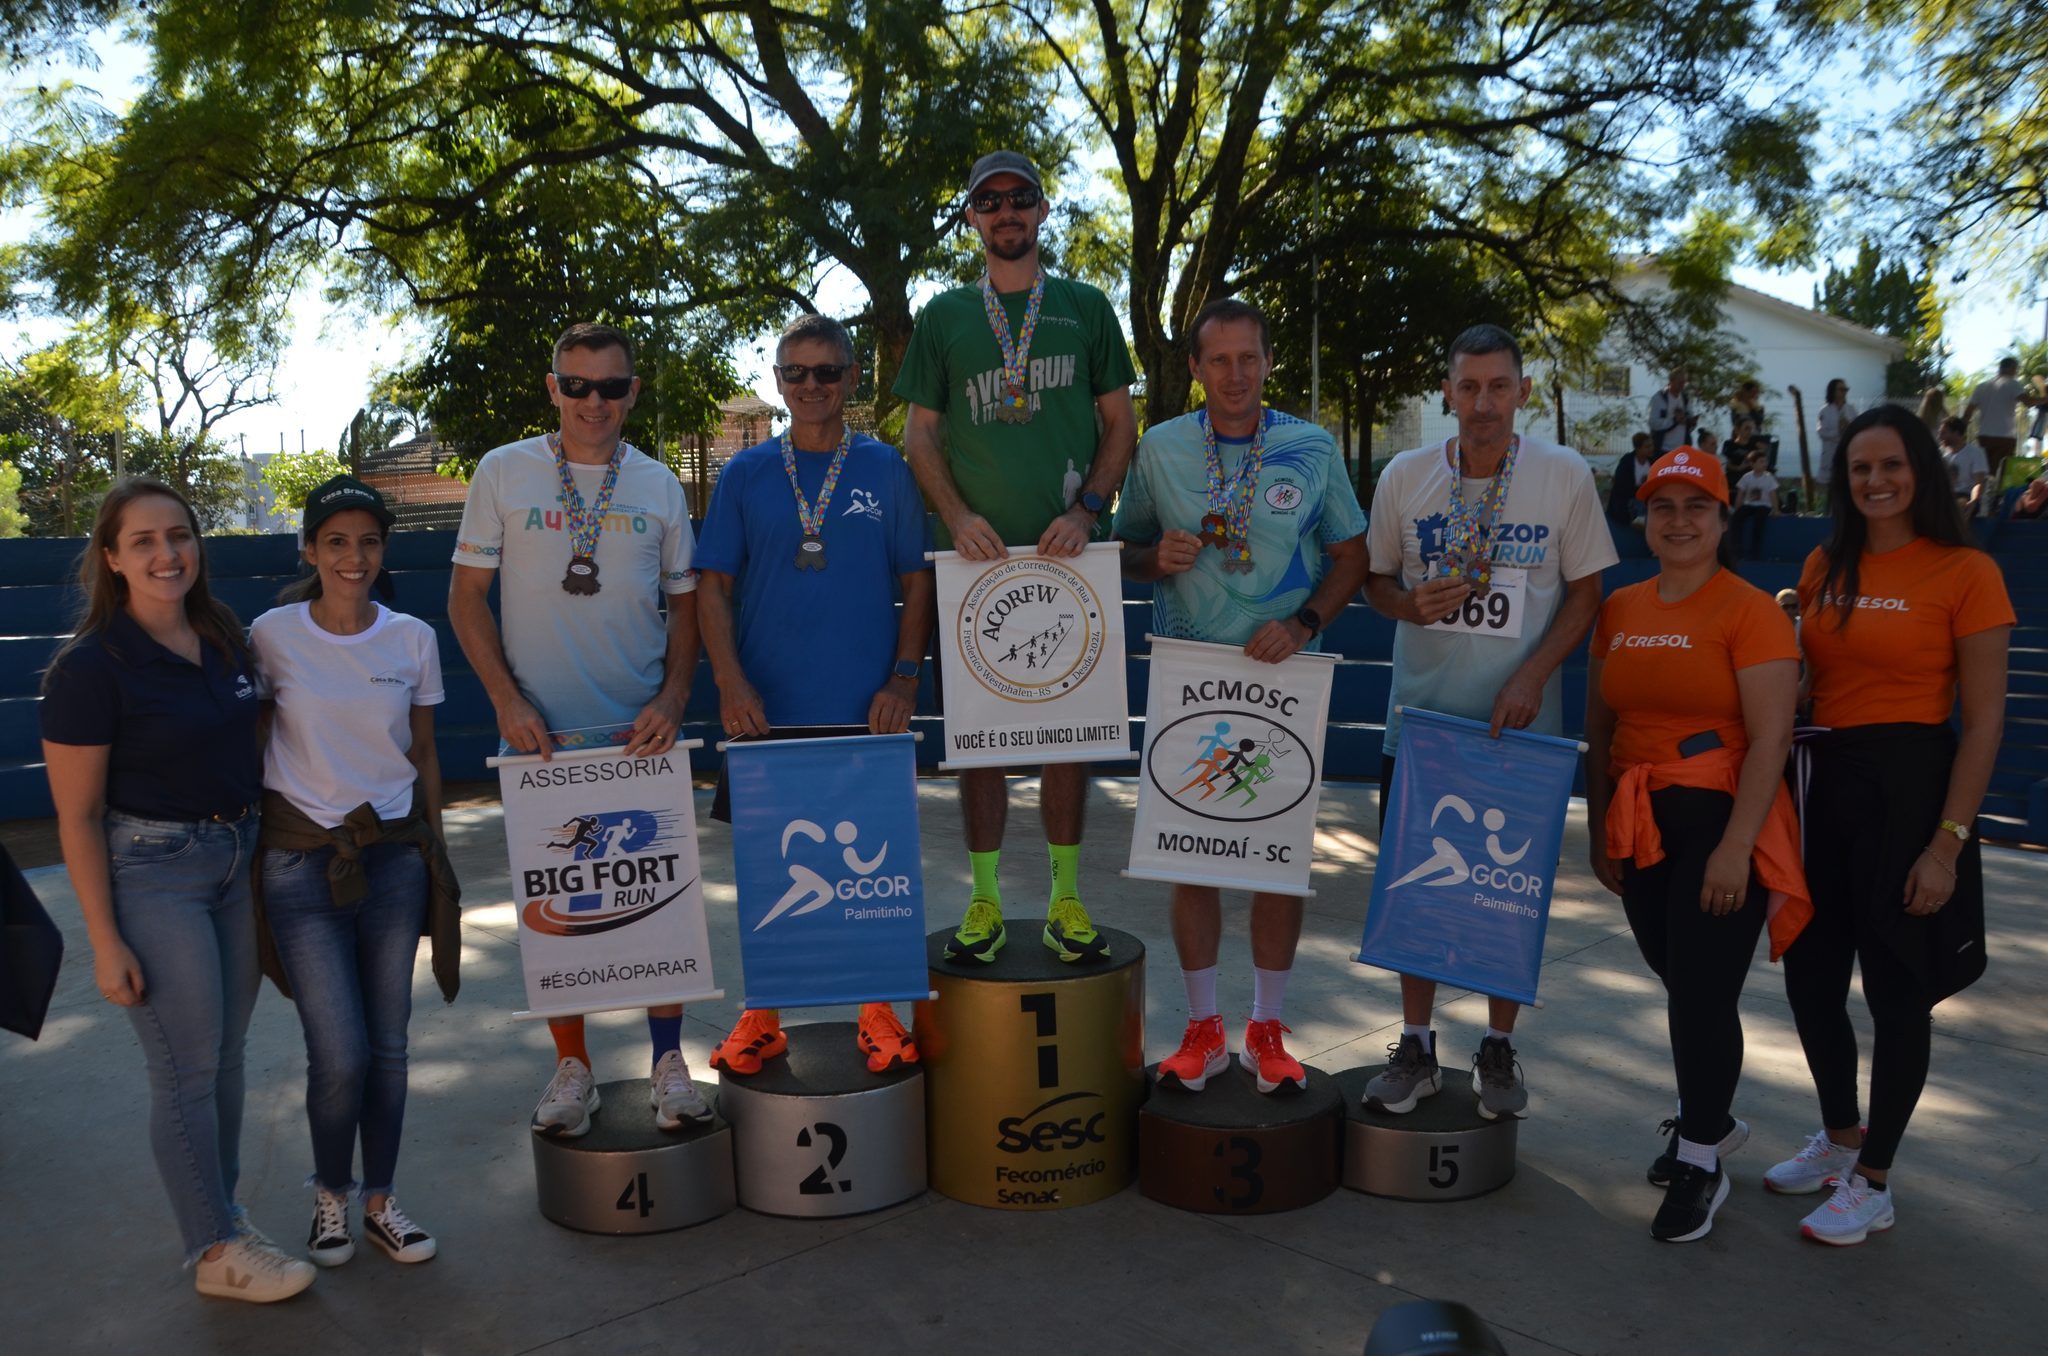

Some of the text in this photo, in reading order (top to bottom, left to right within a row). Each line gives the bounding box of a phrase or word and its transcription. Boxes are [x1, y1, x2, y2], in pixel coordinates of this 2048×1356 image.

[1030, 355, 1075, 392] RUN
[1657, 465, 1704, 478] CRESOL
[320, 490, 342, 503] Casa
[1498, 544, 1547, 564] RUN
[967, 561, 1090, 610] Associação de Corredores de Rua
[982, 583, 1060, 642] ACORFW
[963, 629, 984, 672] Frederico
[1072, 631, 1101, 681] Desde 2024
[1625, 634, 1693, 649] CRESOL
[1181, 680, 1299, 717] ACMOSC
[954, 725, 1120, 750] VOCÊ É O SEU ÚNICO LIMITE!
[519, 756, 674, 790] ASSESSORIA
[1157, 832, 1250, 859] MONDAÍ
[1266, 844, 1291, 863] SC
[524, 854, 679, 898] BIG FORT
[835, 875, 911, 900] GCOR
[1471, 863, 1543, 898] GCOR
[614, 887, 656, 907] RUN
[844, 906, 912, 920] Palmitinho
[1473, 892, 1539, 919] Palmitinho
[540, 958, 698, 990] #ÉSÓNÃOPARAR
[1021, 992, 1059, 1089] 1
[996, 1110, 1106, 1154] Sesc
[797, 1122, 852, 1195] 2
[996, 1158, 1106, 1183] Fecomércio
[1213, 1136, 1264, 1209] 3
[1427, 1145, 1459, 1189] 5
[616, 1172, 654, 1218] 4
[998, 1188, 1060, 1205] Senac
